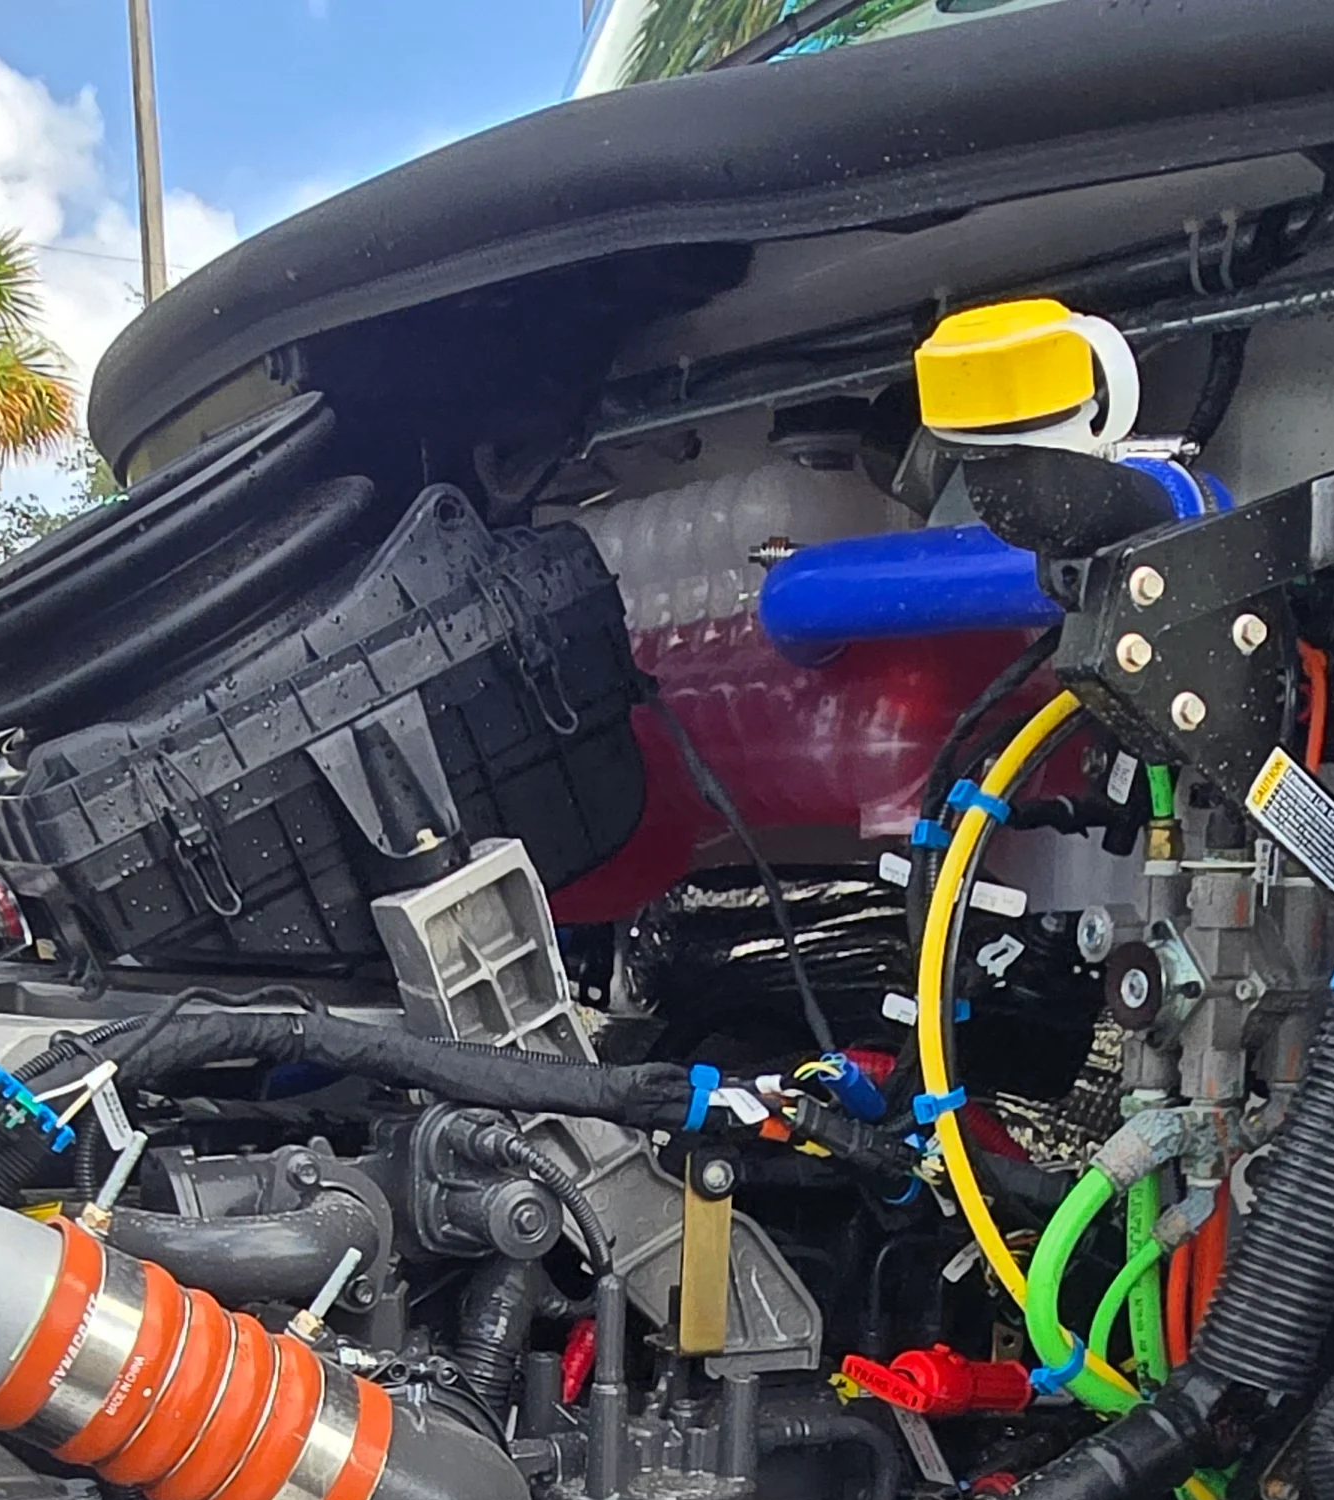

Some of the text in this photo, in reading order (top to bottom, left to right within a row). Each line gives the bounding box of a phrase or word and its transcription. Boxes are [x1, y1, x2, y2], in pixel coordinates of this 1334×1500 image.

[1250, 758, 1284, 805] CAUTION
[124, 1352, 145, 1383] CHINA
[118, 1380, 132, 1393] IN
[103, 1389, 127, 1417] MADE
